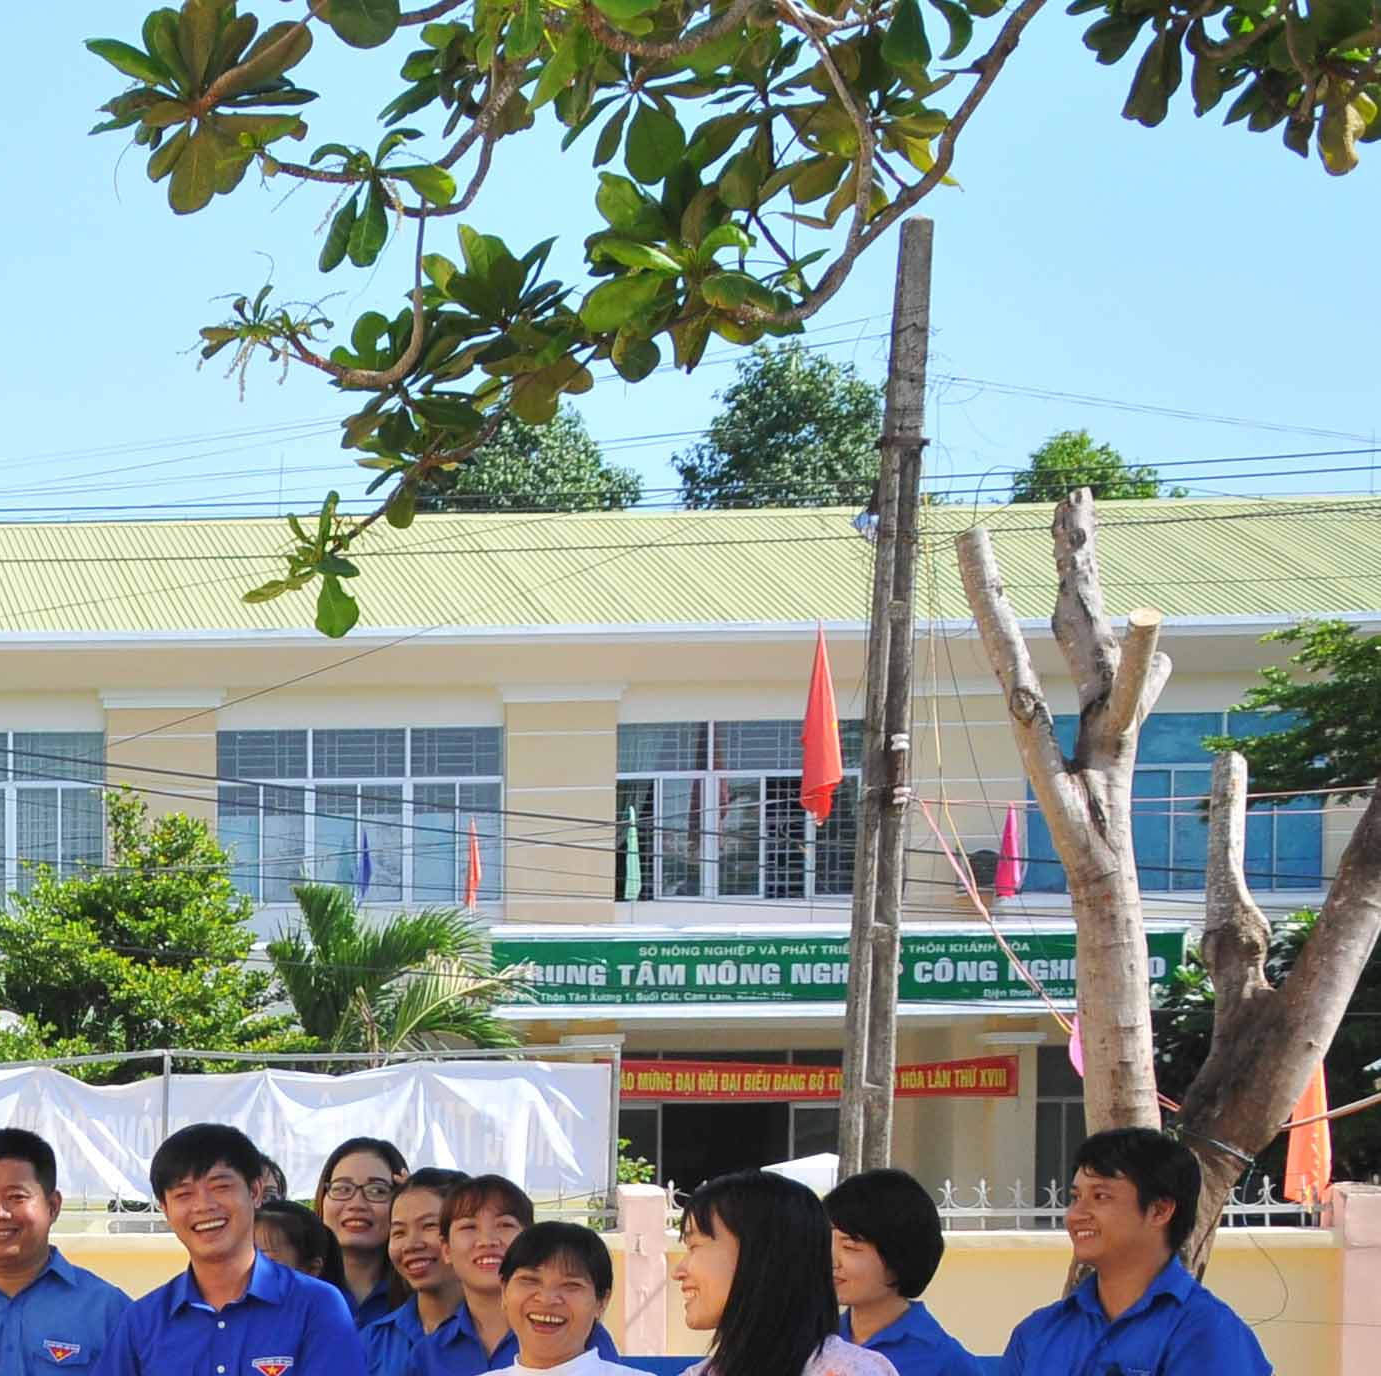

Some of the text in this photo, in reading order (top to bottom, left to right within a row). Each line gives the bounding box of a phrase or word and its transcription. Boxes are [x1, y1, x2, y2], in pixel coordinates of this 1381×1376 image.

[523, 963, 608, 987] RUNG
[617, 960, 687, 986] TÂM
[695, 959, 782, 985] NÔNG
[913, 957, 999, 984] CÔNG
